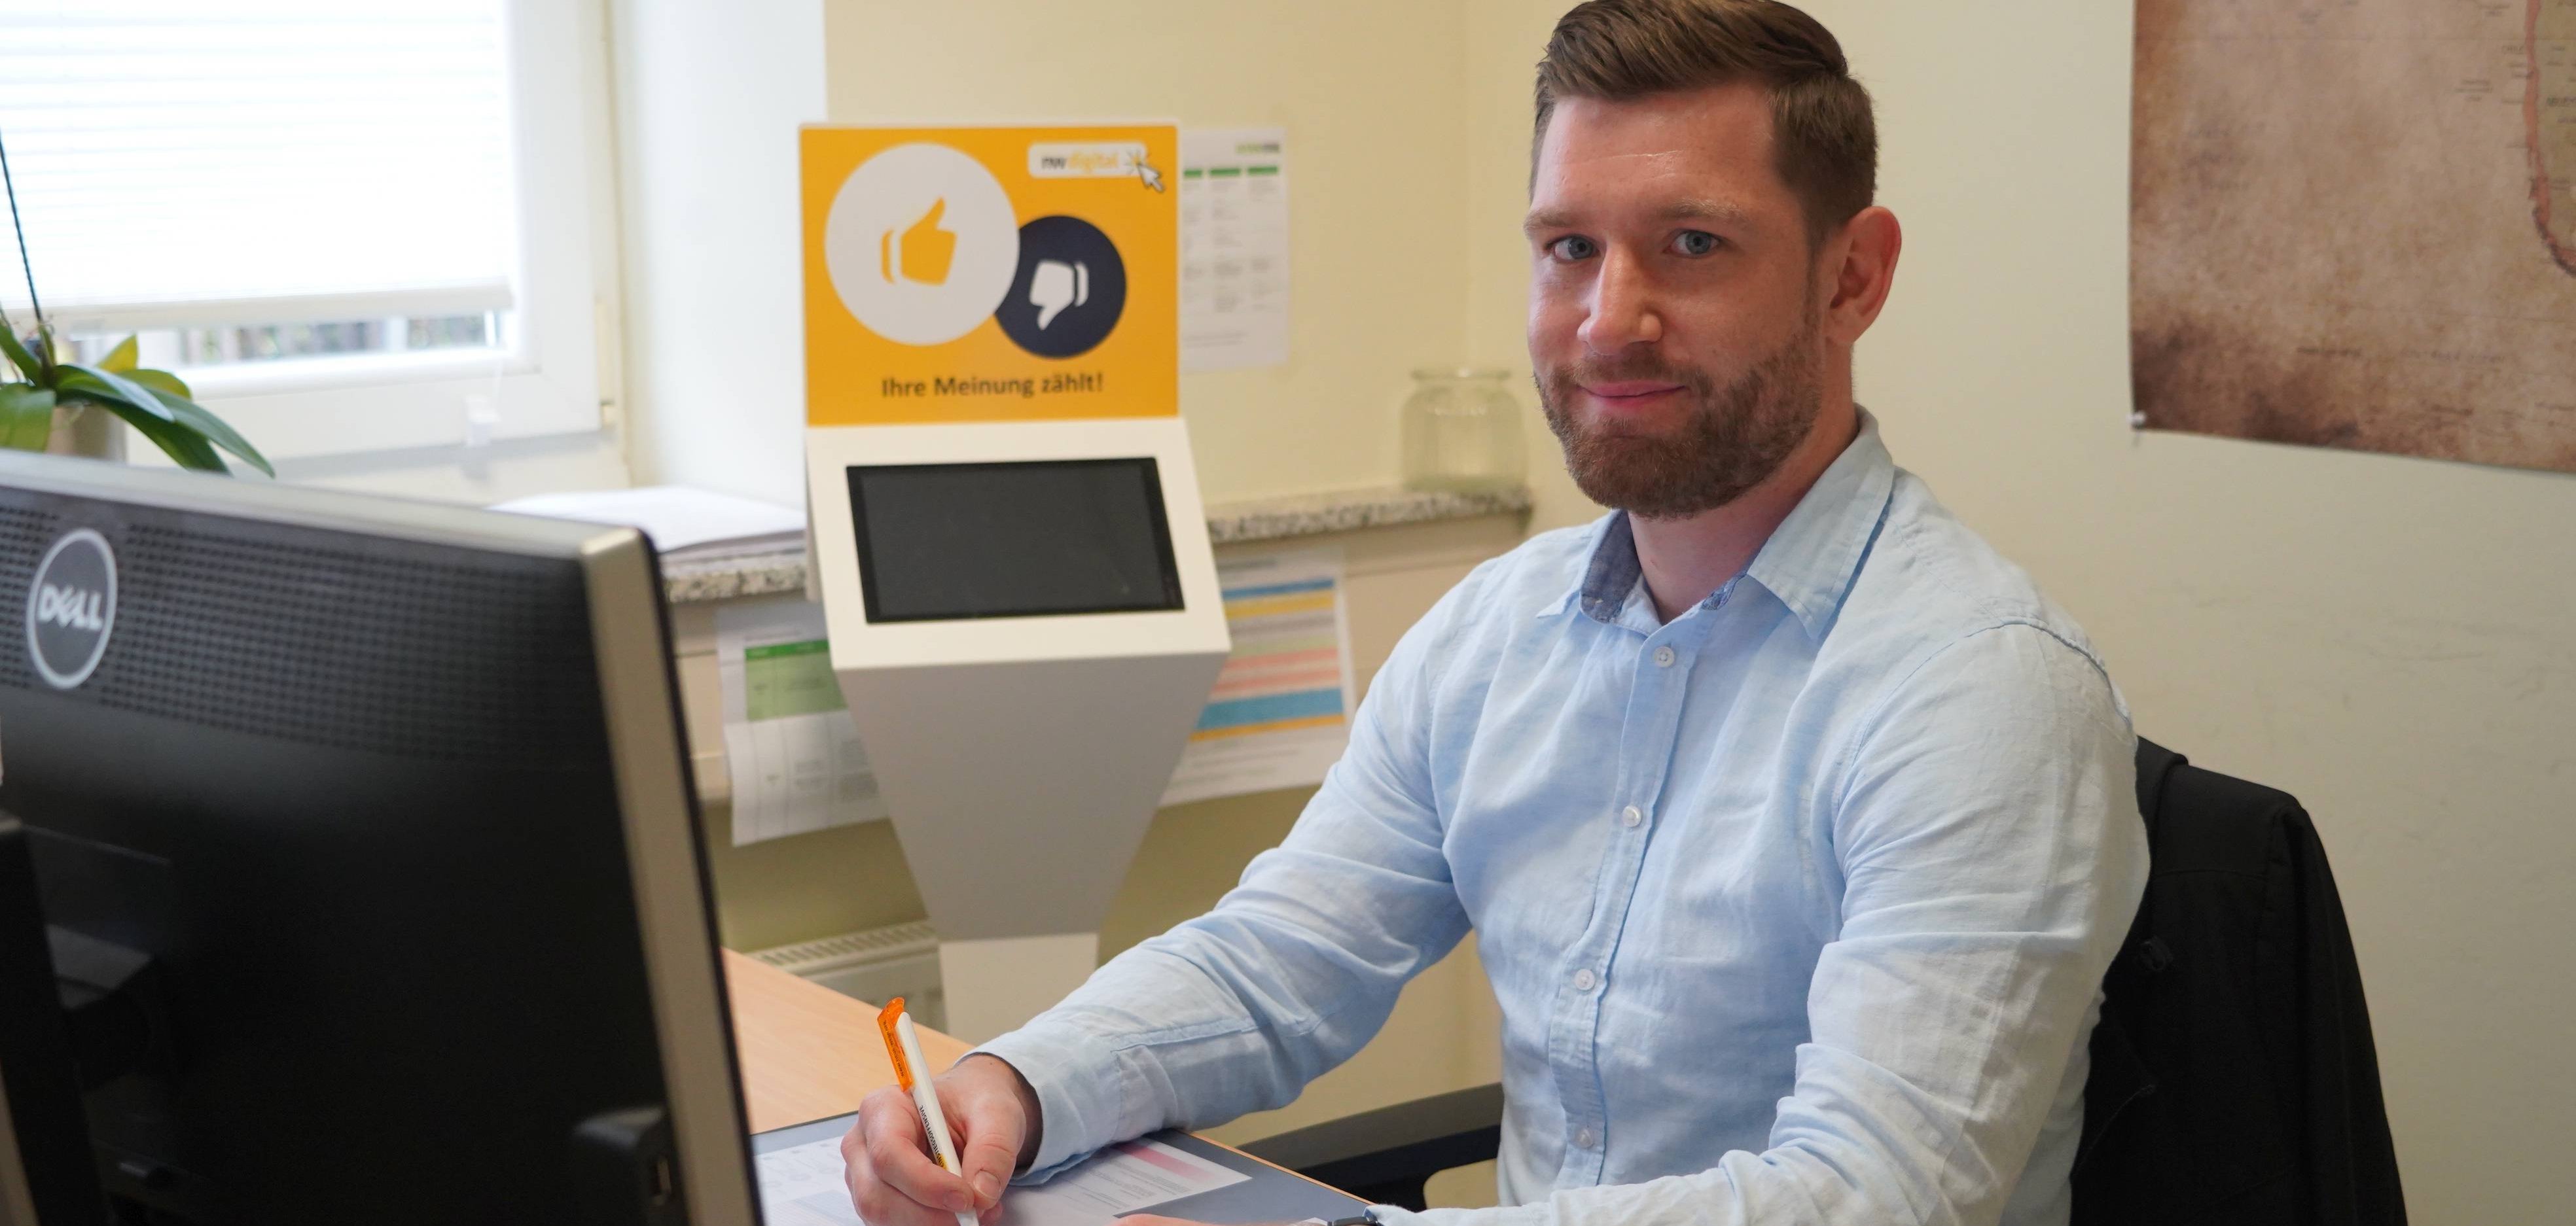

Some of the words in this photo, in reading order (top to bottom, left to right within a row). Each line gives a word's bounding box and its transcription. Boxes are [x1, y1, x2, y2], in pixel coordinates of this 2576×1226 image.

[882, 377, 926, 397] Ihre
[934, 376, 1034, 398] Meinung
[1041, 372, 1103, 393] zählt!
[37, 584, 103, 630] DELL
